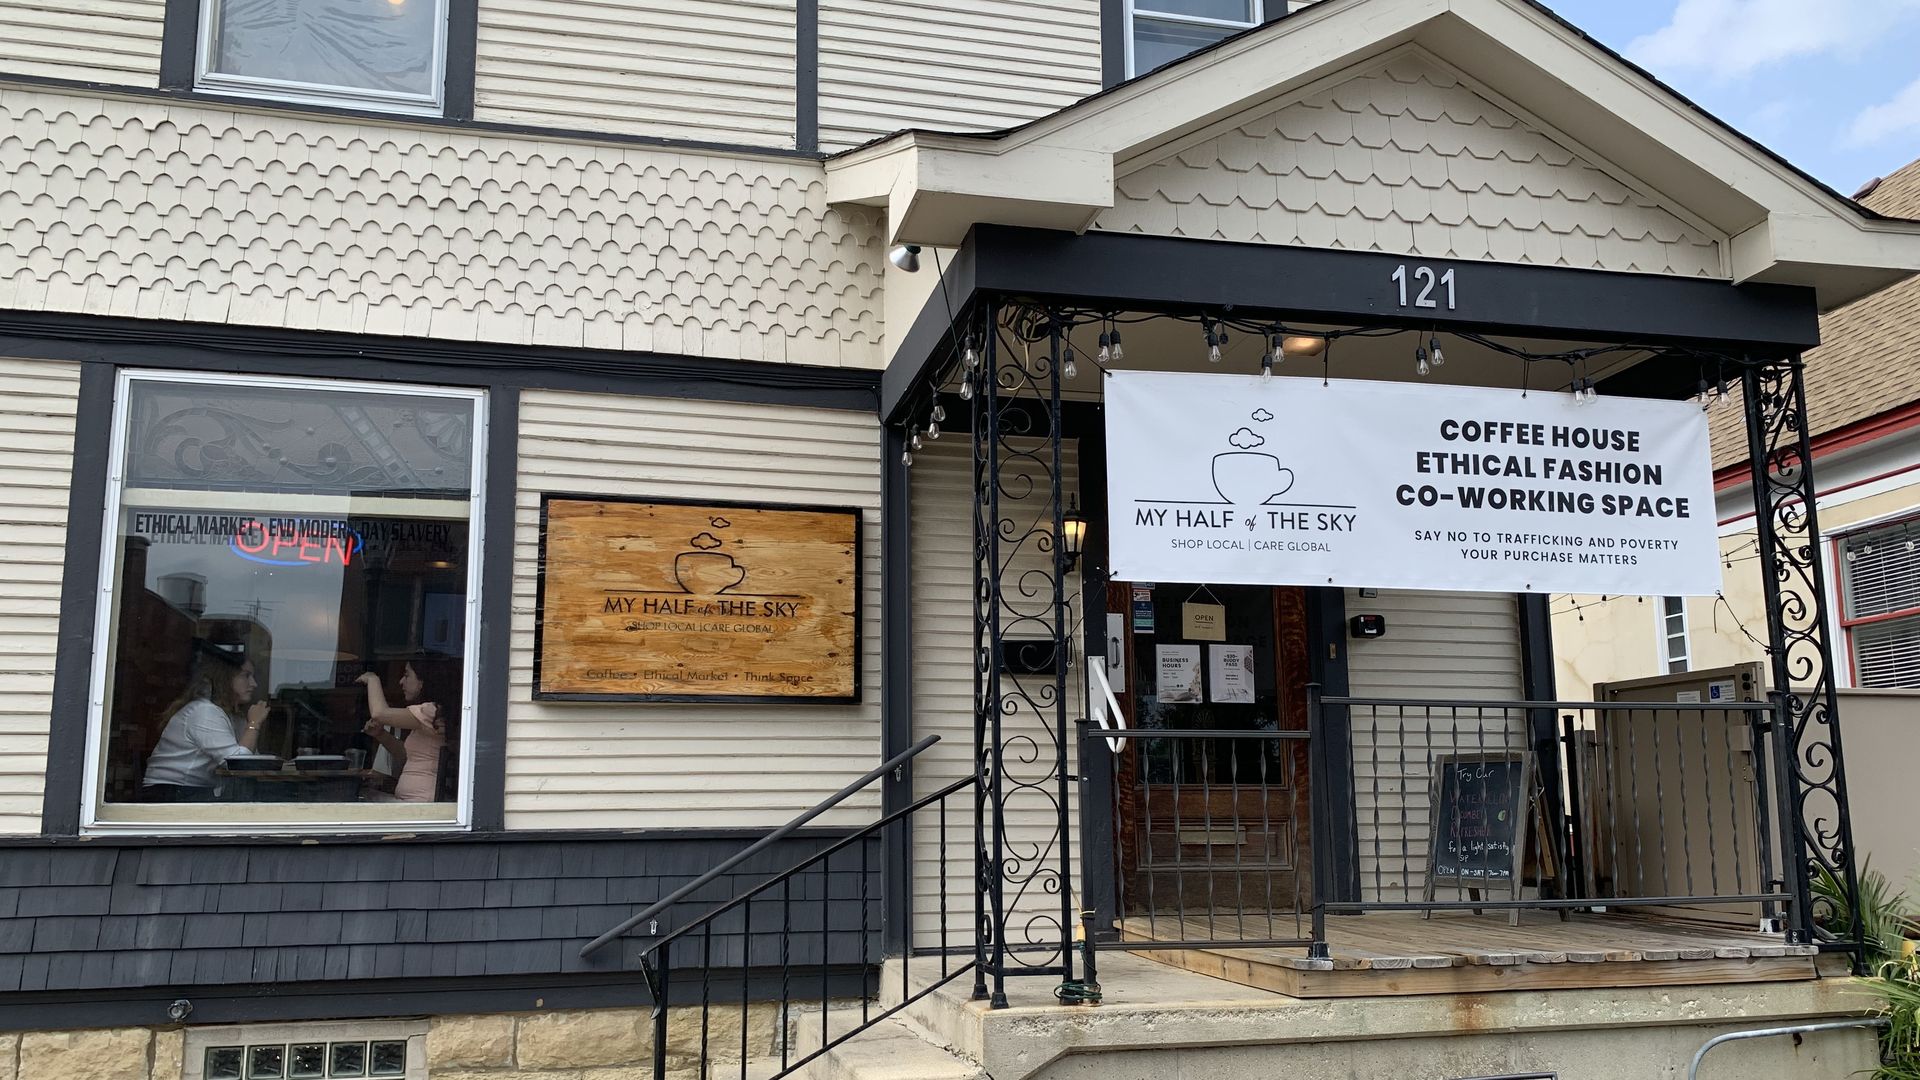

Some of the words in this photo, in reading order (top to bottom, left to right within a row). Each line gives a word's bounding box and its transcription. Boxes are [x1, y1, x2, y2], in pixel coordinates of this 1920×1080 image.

[1391, 264, 1456, 310] 121
[1440, 419, 1545, 446] COFFEE
[1551, 425, 1640, 452] HOUSE
[1416, 451, 1537, 478] ETHICAL
[1543, 458, 1663, 486] FASHION
[1396, 484, 1595, 514] CO-WORKING
[1602, 495, 1690, 518] SPACE
[135, 513, 193, 534] ETHICAL
[196, 515, 255, 535] MARKET
[269, 518, 296, 537] END
[391, 522, 450, 543] SLAVERY
[1135, 507, 1168, 526] MY
[1176, 509, 1234, 528] HALF
[1244, 514, 1257, 532] of
[1267, 511, 1309, 530] THE
[1317, 513, 1357, 532] SKY
[237, 521, 354, 566] OPEN
[1171, 539, 1204, 549] SHOP
[1206, 539, 1245, 550] LOCAL
[1253, 540, 1284, 550] CARE
[1287, 541, 1332, 552] GLOBAL
[1414, 530, 1441, 541] SAY
[1447, 531, 1467, 542] NO
[1473, 532, 1491, 543] TO
[1497, 533, 1583, 547] TRAFFICKING
[1588, 537, 1615, 548] AND
[1621, 538, 1679, 550] POVERTY
[1460, 548, 1498, 560] YOUR
[1504, 550, 1573, 563] PURCHASE
[1578, 553, 1638, 565] MATTERS
[604, 597, 637, 613] MY
[643, 598, 695, 615] HALF
[717, 599, 756, 617] THE
[763, 601, 800, 618] SKY
[631, 621, 661, 631] SHOP
[664, 622, 700, 632] LOCAL
[702, 623, 730, 632] CARE
[733, 623, 774, 634] GLOBAL
[586, 669, 627, 680] Coffee
[643, 669, 683, 681] Ethical
[687, 671, 729, 681] Market
[744, 671, 775, 682] Think
[779, 673, 814, 685] Space
[1457, 768, 1472, 783] Try
[1437, 865, 1455, 875] OPEN
